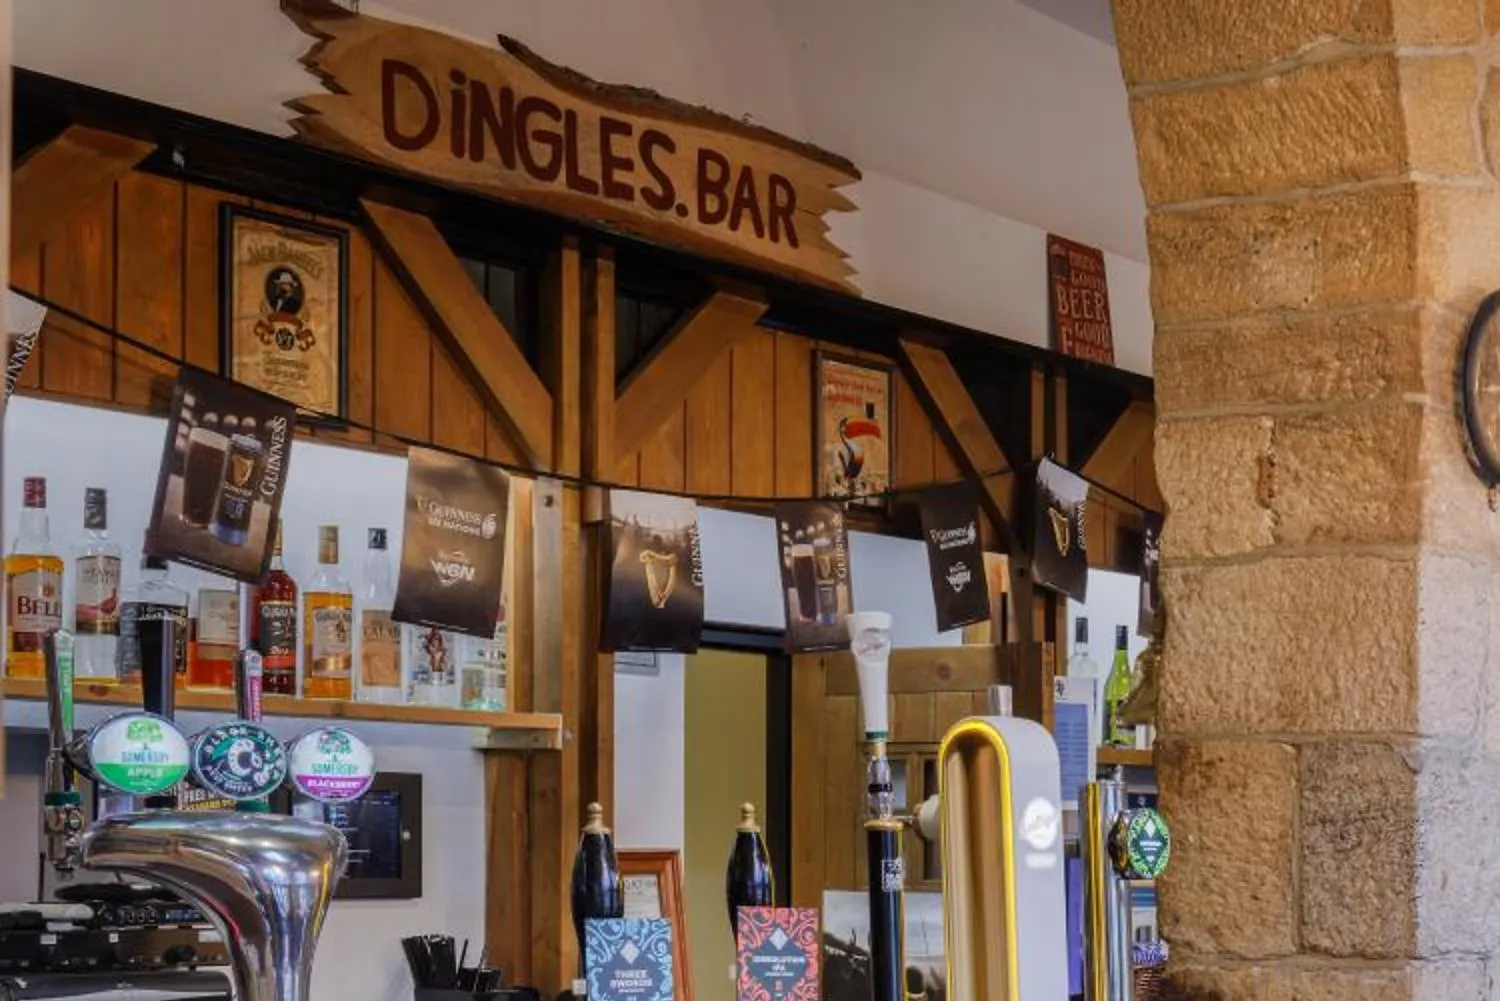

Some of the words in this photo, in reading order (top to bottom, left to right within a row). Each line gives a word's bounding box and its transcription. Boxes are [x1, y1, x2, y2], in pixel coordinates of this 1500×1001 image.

[1056, 281, 1108, 323] BEER
[260, 415, 288, 497] GUINNESS
[127, 769, 163, 779] APPLE
